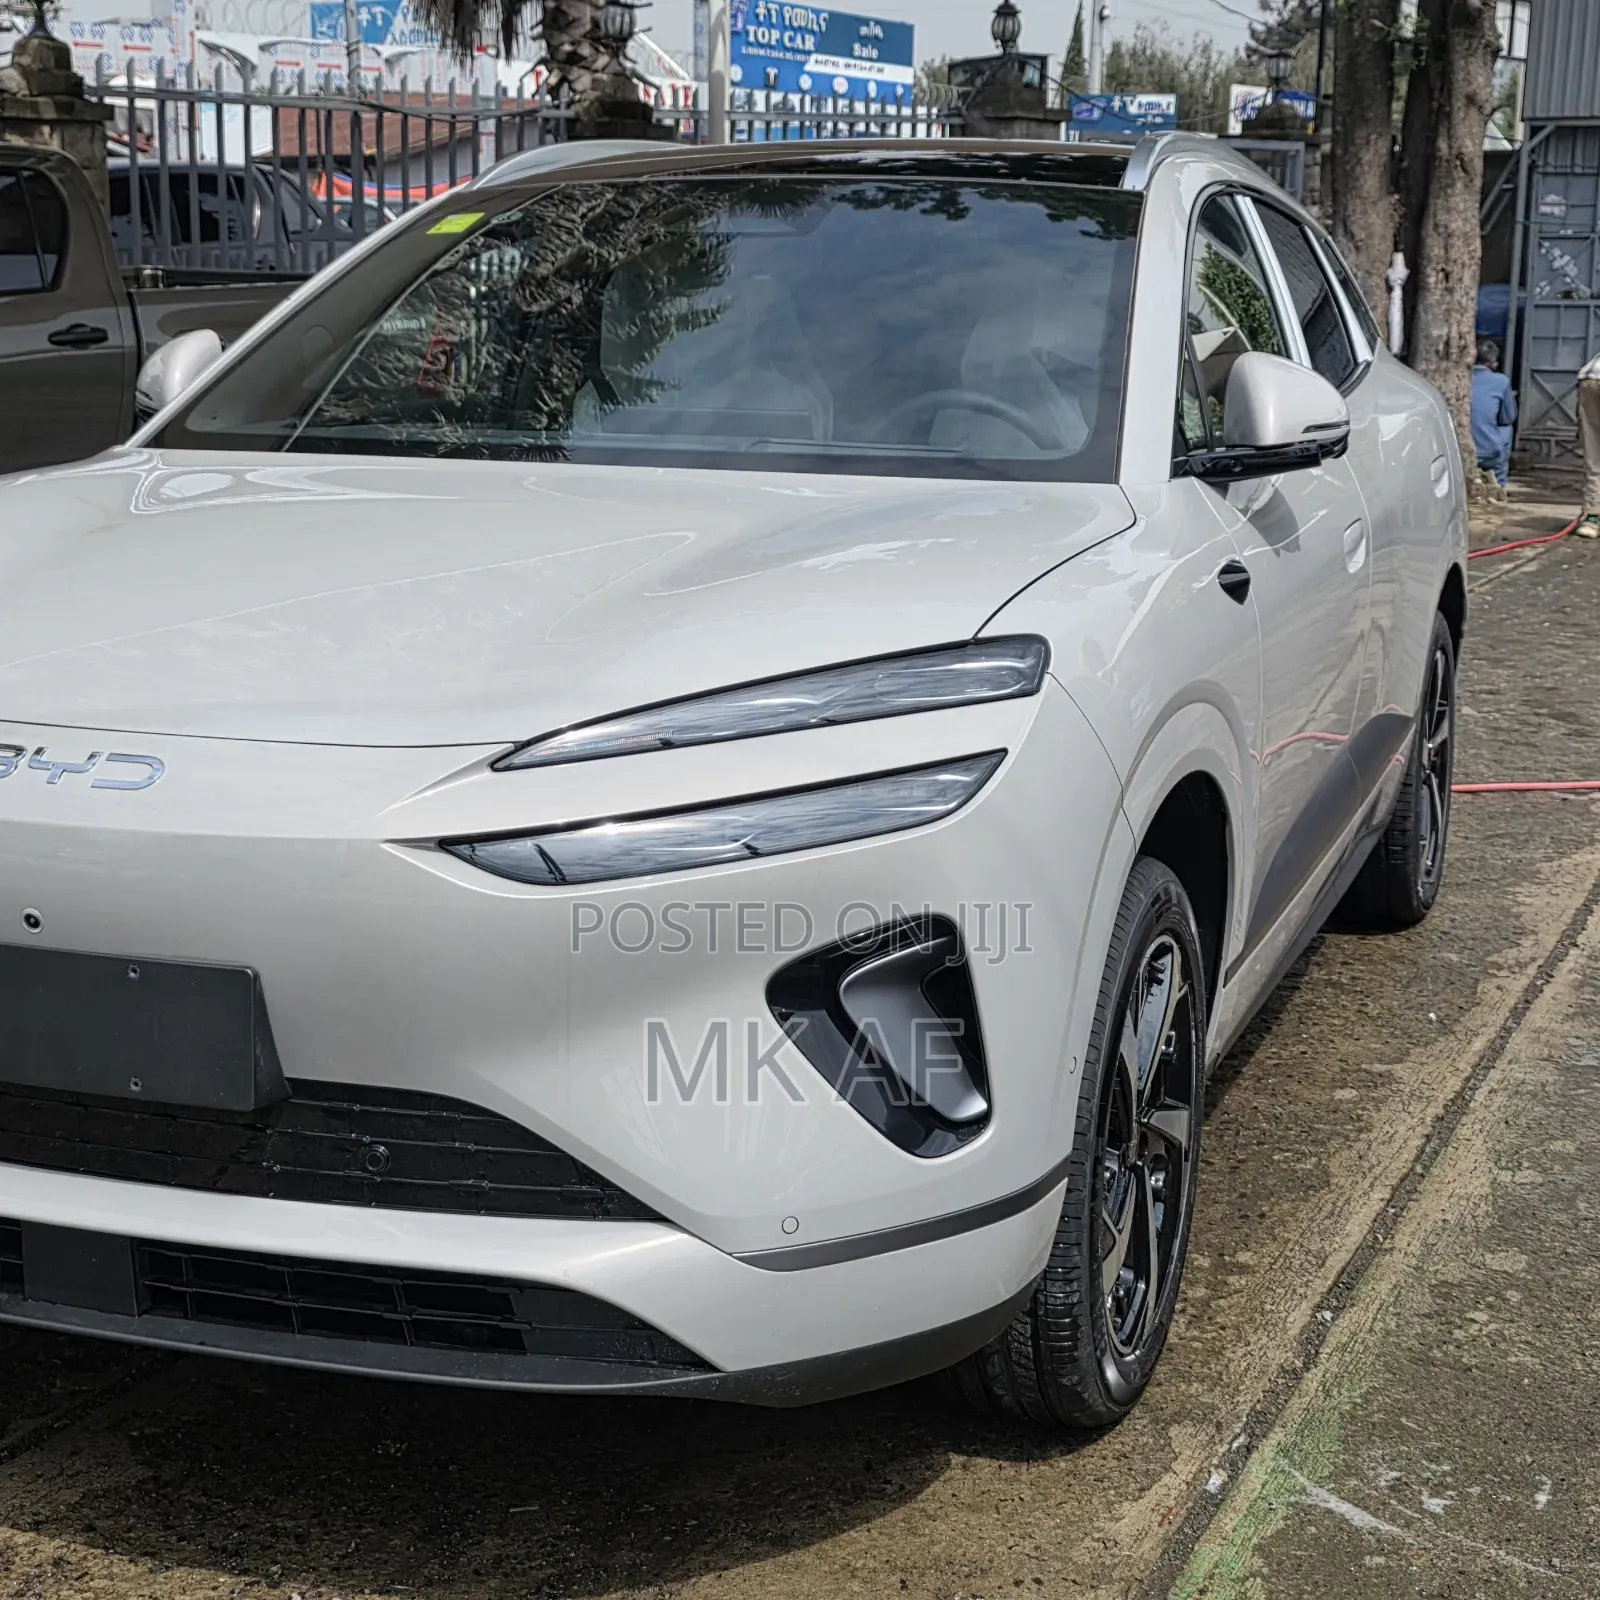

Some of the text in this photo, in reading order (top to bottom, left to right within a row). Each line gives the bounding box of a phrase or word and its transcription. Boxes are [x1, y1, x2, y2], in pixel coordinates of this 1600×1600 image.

[745, 25, 816, 52] TOP CAR
[852, 42, 879, 60] Sale
